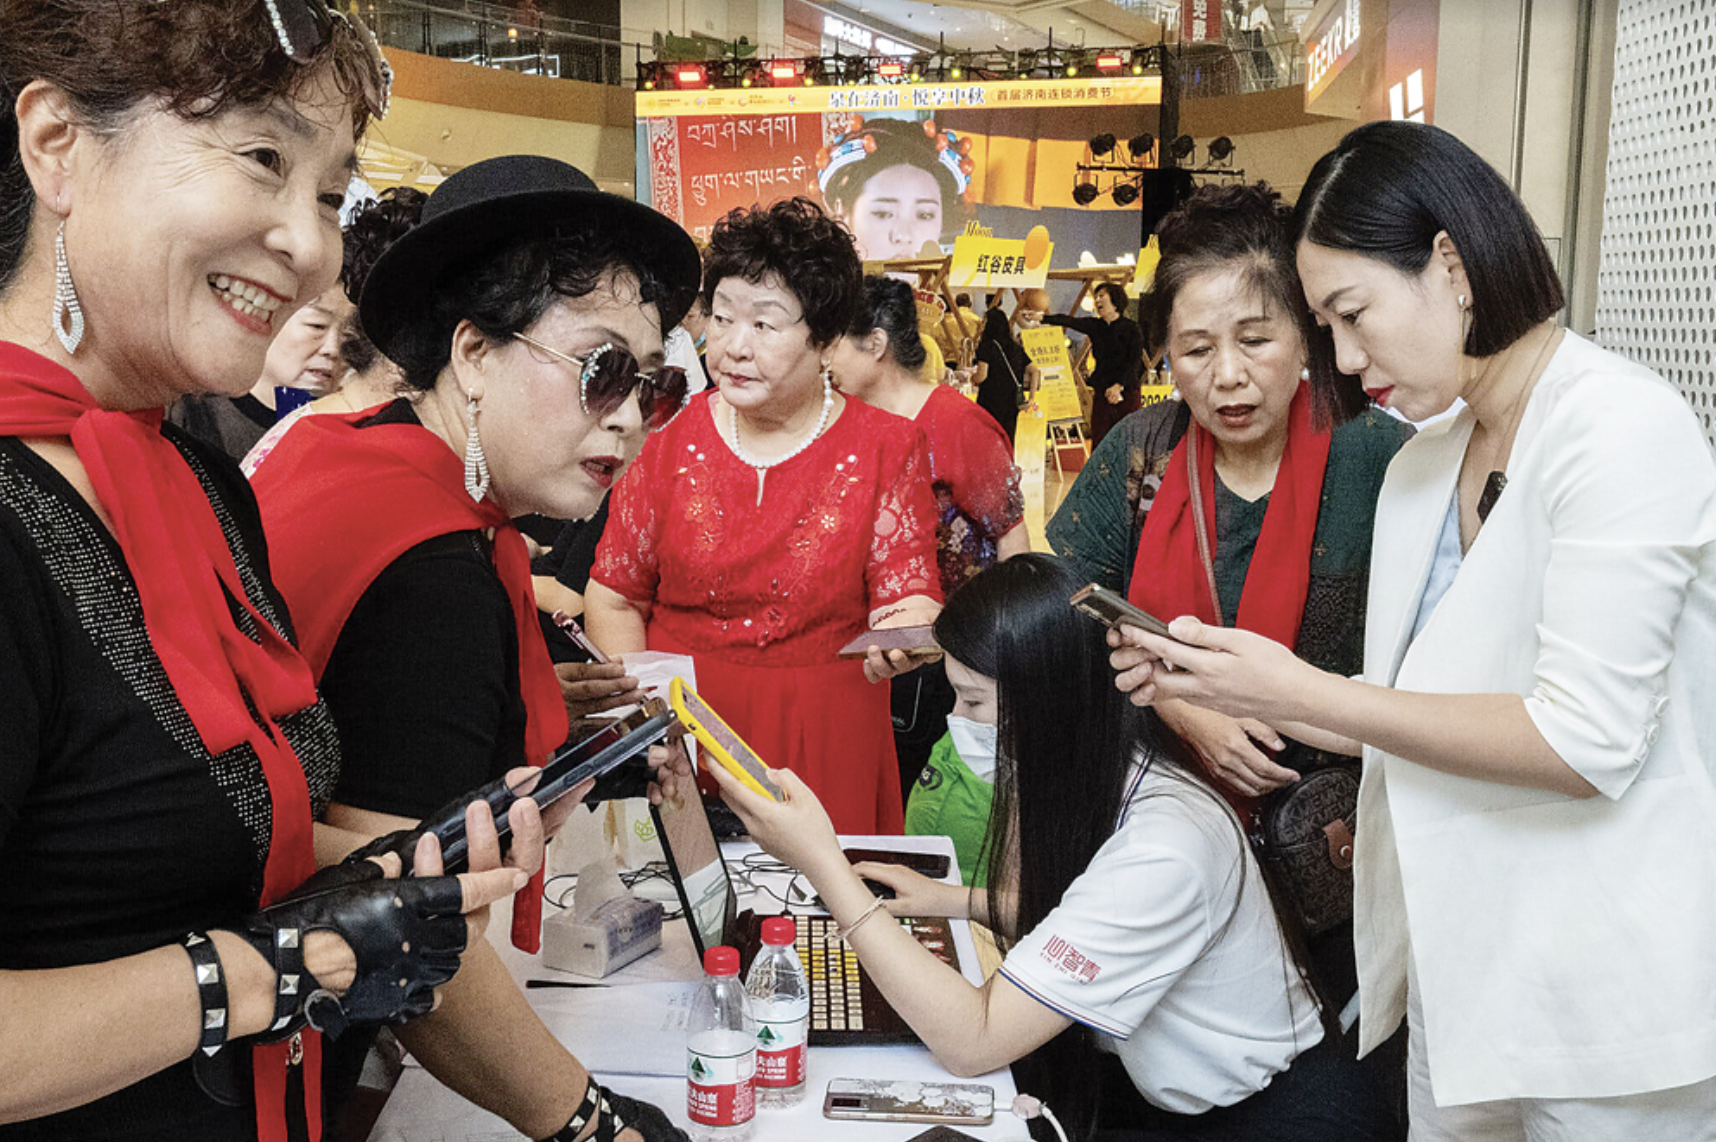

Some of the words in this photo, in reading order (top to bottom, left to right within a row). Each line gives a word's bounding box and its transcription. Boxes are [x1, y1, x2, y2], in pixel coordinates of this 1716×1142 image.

[1308, 16, 1343, 92] ZEEKR
[996, 86, 1113, 101] 首届济南连锁消费节
[976, 254, 1026, 275] 红谷皮具
